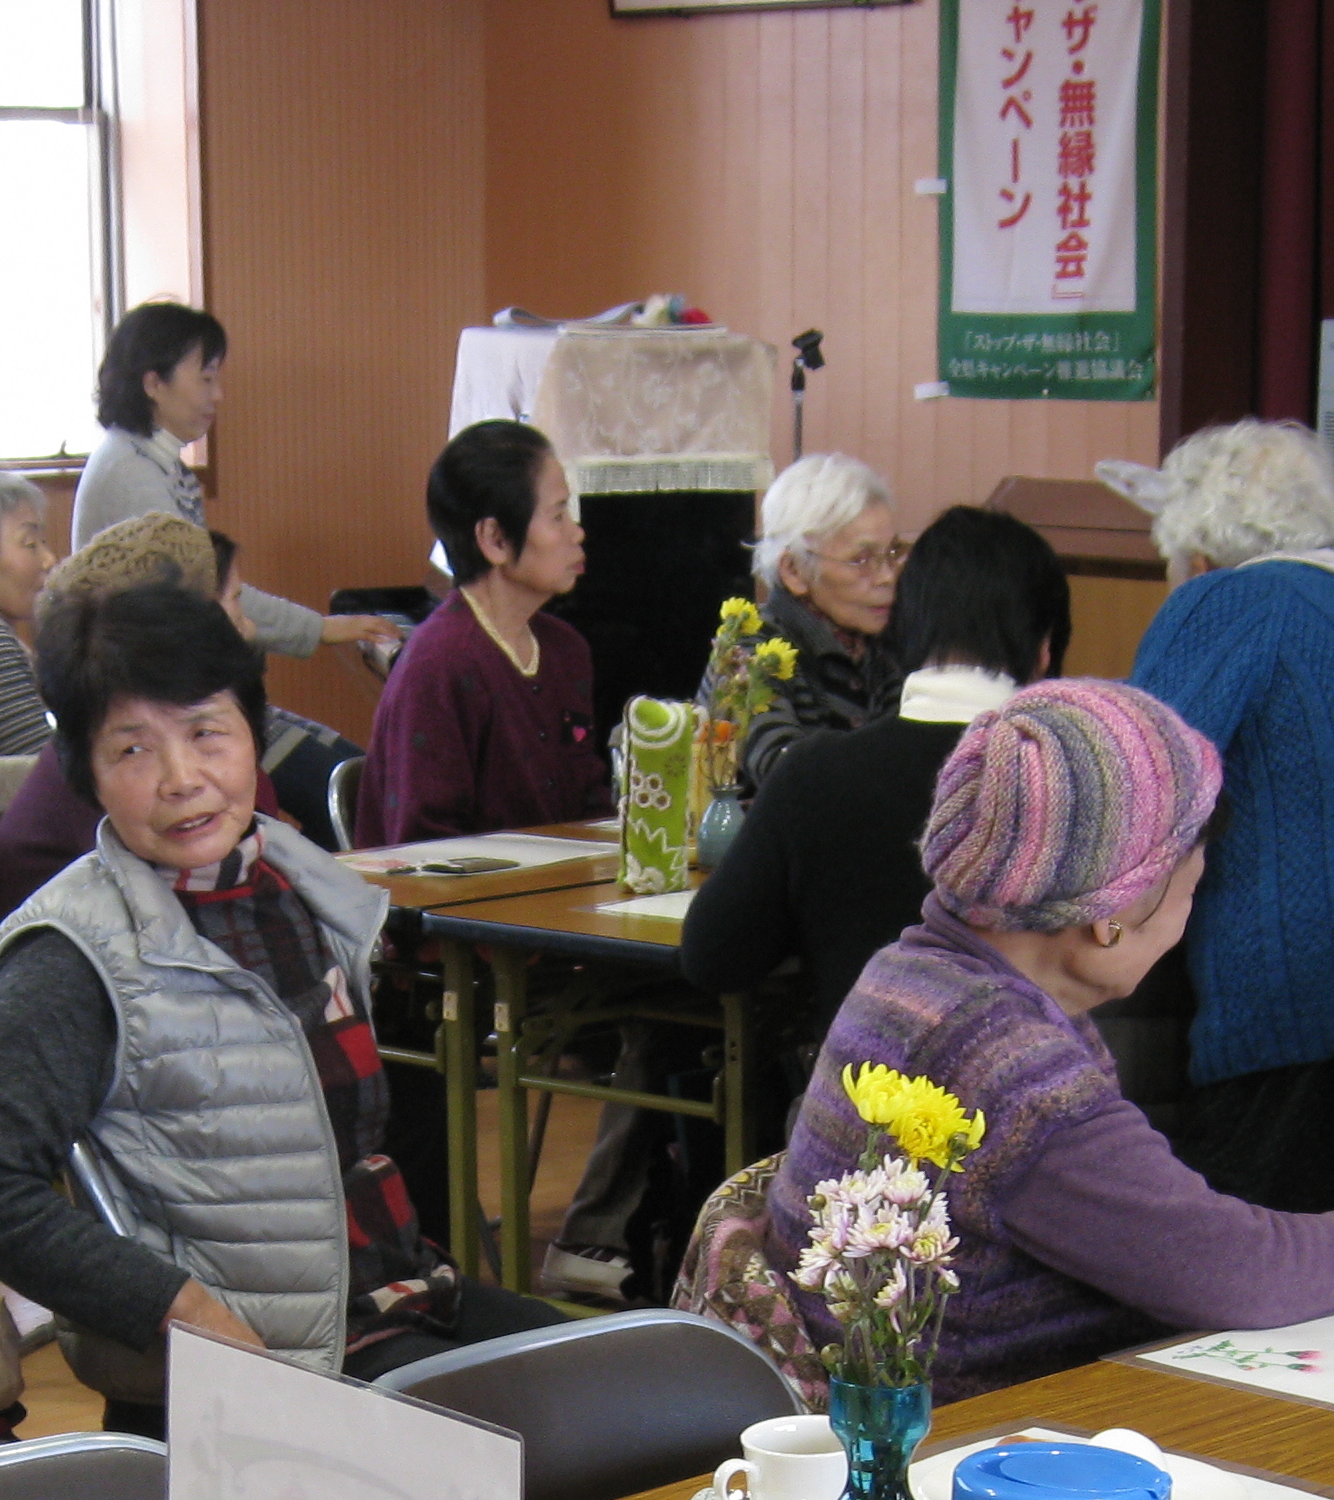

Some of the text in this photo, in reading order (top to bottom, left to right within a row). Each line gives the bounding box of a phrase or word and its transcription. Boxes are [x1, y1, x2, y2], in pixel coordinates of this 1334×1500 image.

[998, 0, 1036, 229] ャンペーン
[1051, 0, 1099, 300] ザ・無縁社会』
